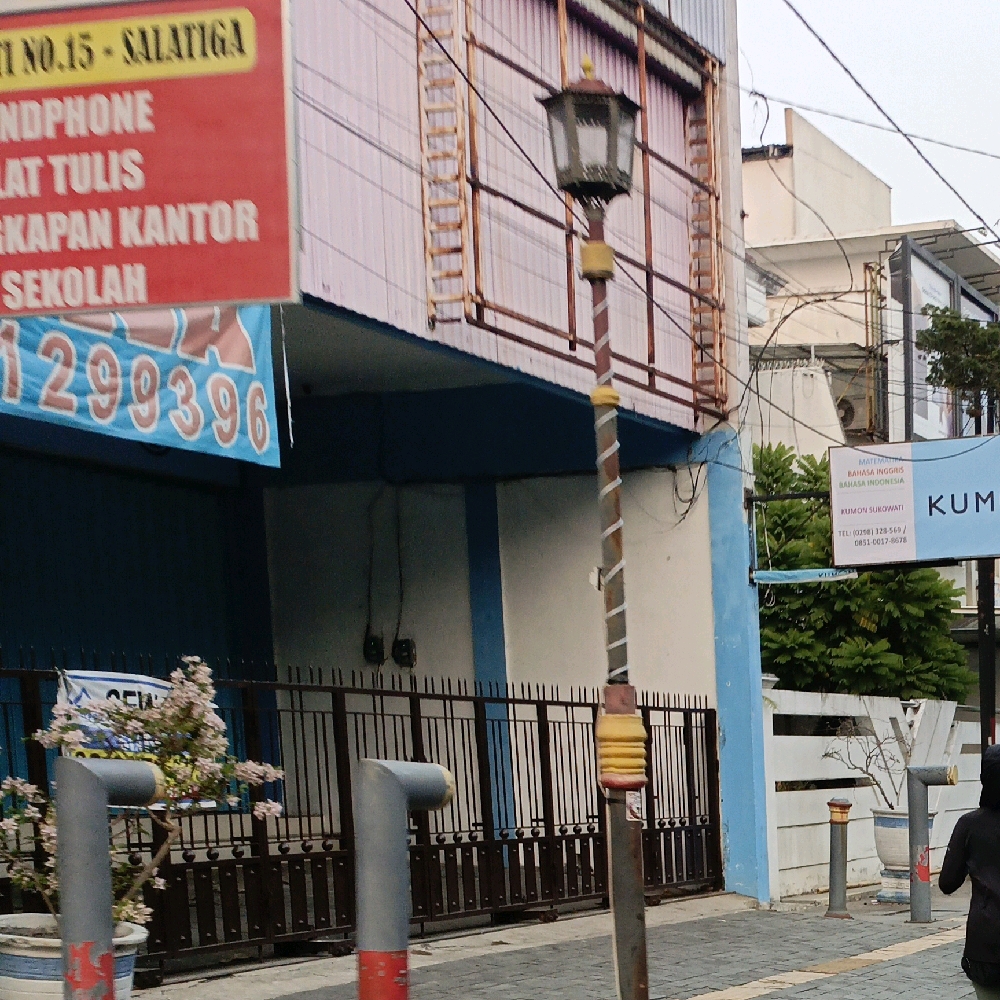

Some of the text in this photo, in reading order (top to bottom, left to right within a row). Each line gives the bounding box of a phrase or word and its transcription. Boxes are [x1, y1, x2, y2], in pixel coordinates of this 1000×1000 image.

[0, 39, 16, 77] I
[21, 31, 95, 74] NO.15
[121, 18, 247, 67] SALATIGA
[46, 148, 146, 197] TULIS
[0, 199, 259, 255] KAPAN KANTOR
[1, 263, 148, 311] SEKOLAH
[838, 477, 905, 489] BAHASA INDONESIA
[847, 465, 905, 478] BAHASA INGGRIS
[840, 504, 904, 516] KUMON SUKOWATI
